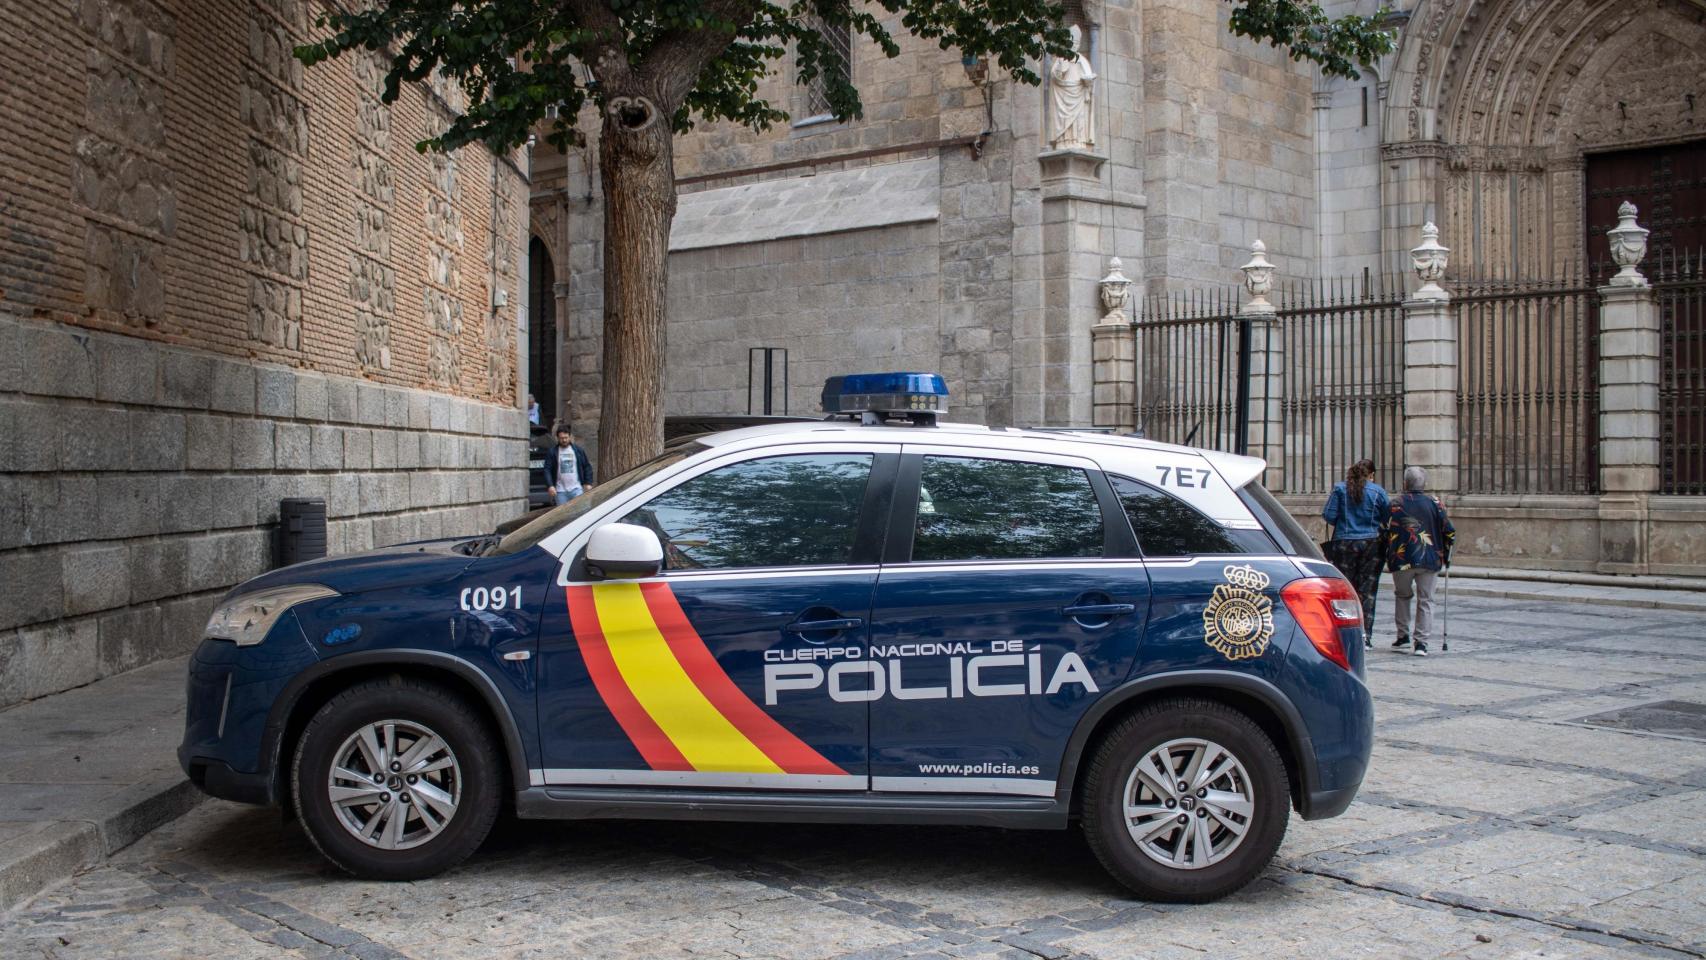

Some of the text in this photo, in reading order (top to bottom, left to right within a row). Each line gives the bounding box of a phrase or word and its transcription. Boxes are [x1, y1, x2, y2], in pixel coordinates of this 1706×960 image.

[1155, 465, 1211, 489] 7E7
[472, 585, 522, 611] 091
[763, 639, 1024, 662] CUERPO NACIONAL DE
[763, 644, 1100, 706] POLICÍA
[918, 762, 1040, 776] www.policia.es
